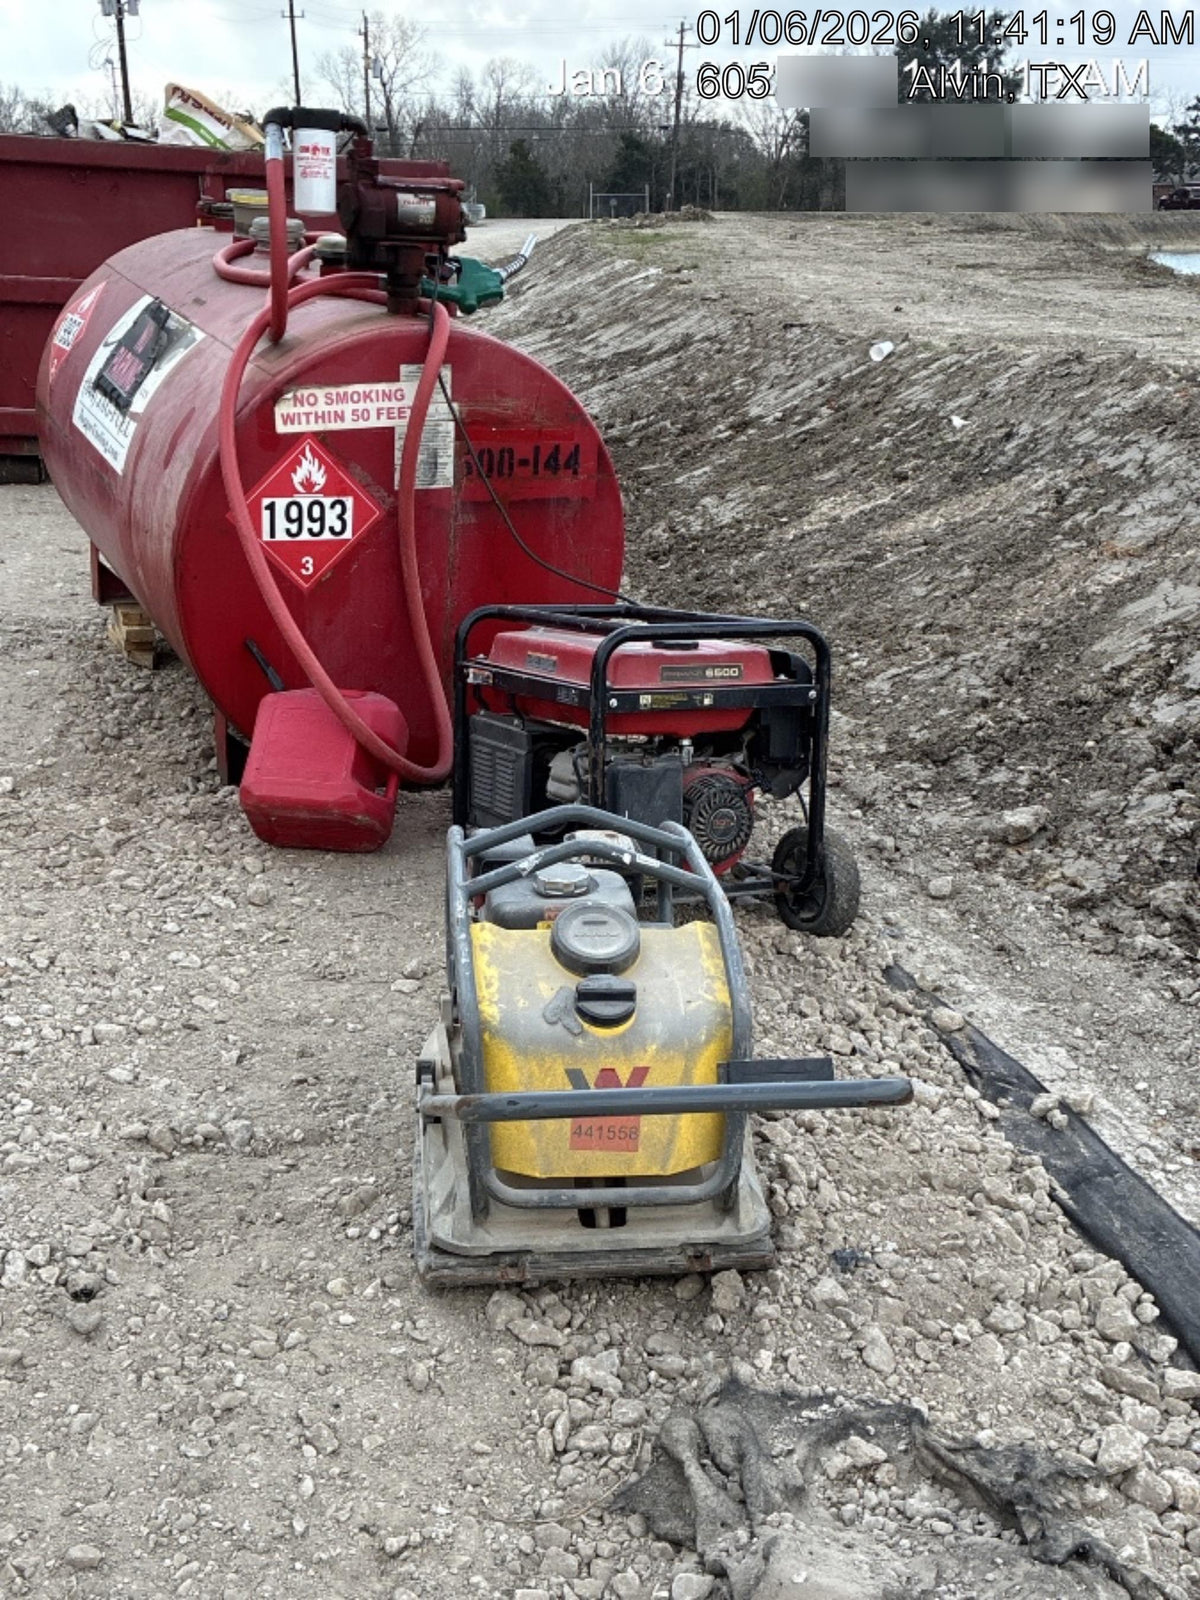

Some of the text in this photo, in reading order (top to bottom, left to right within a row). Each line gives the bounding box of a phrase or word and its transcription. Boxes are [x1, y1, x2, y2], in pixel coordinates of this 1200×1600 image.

[293, 388, 406, 408] NO SMOKING
[281, 406, 412, 426] WITHIN 50 FEE
[264, 499, 348, 539] 1993
[301, 556, 314, 576] 3
